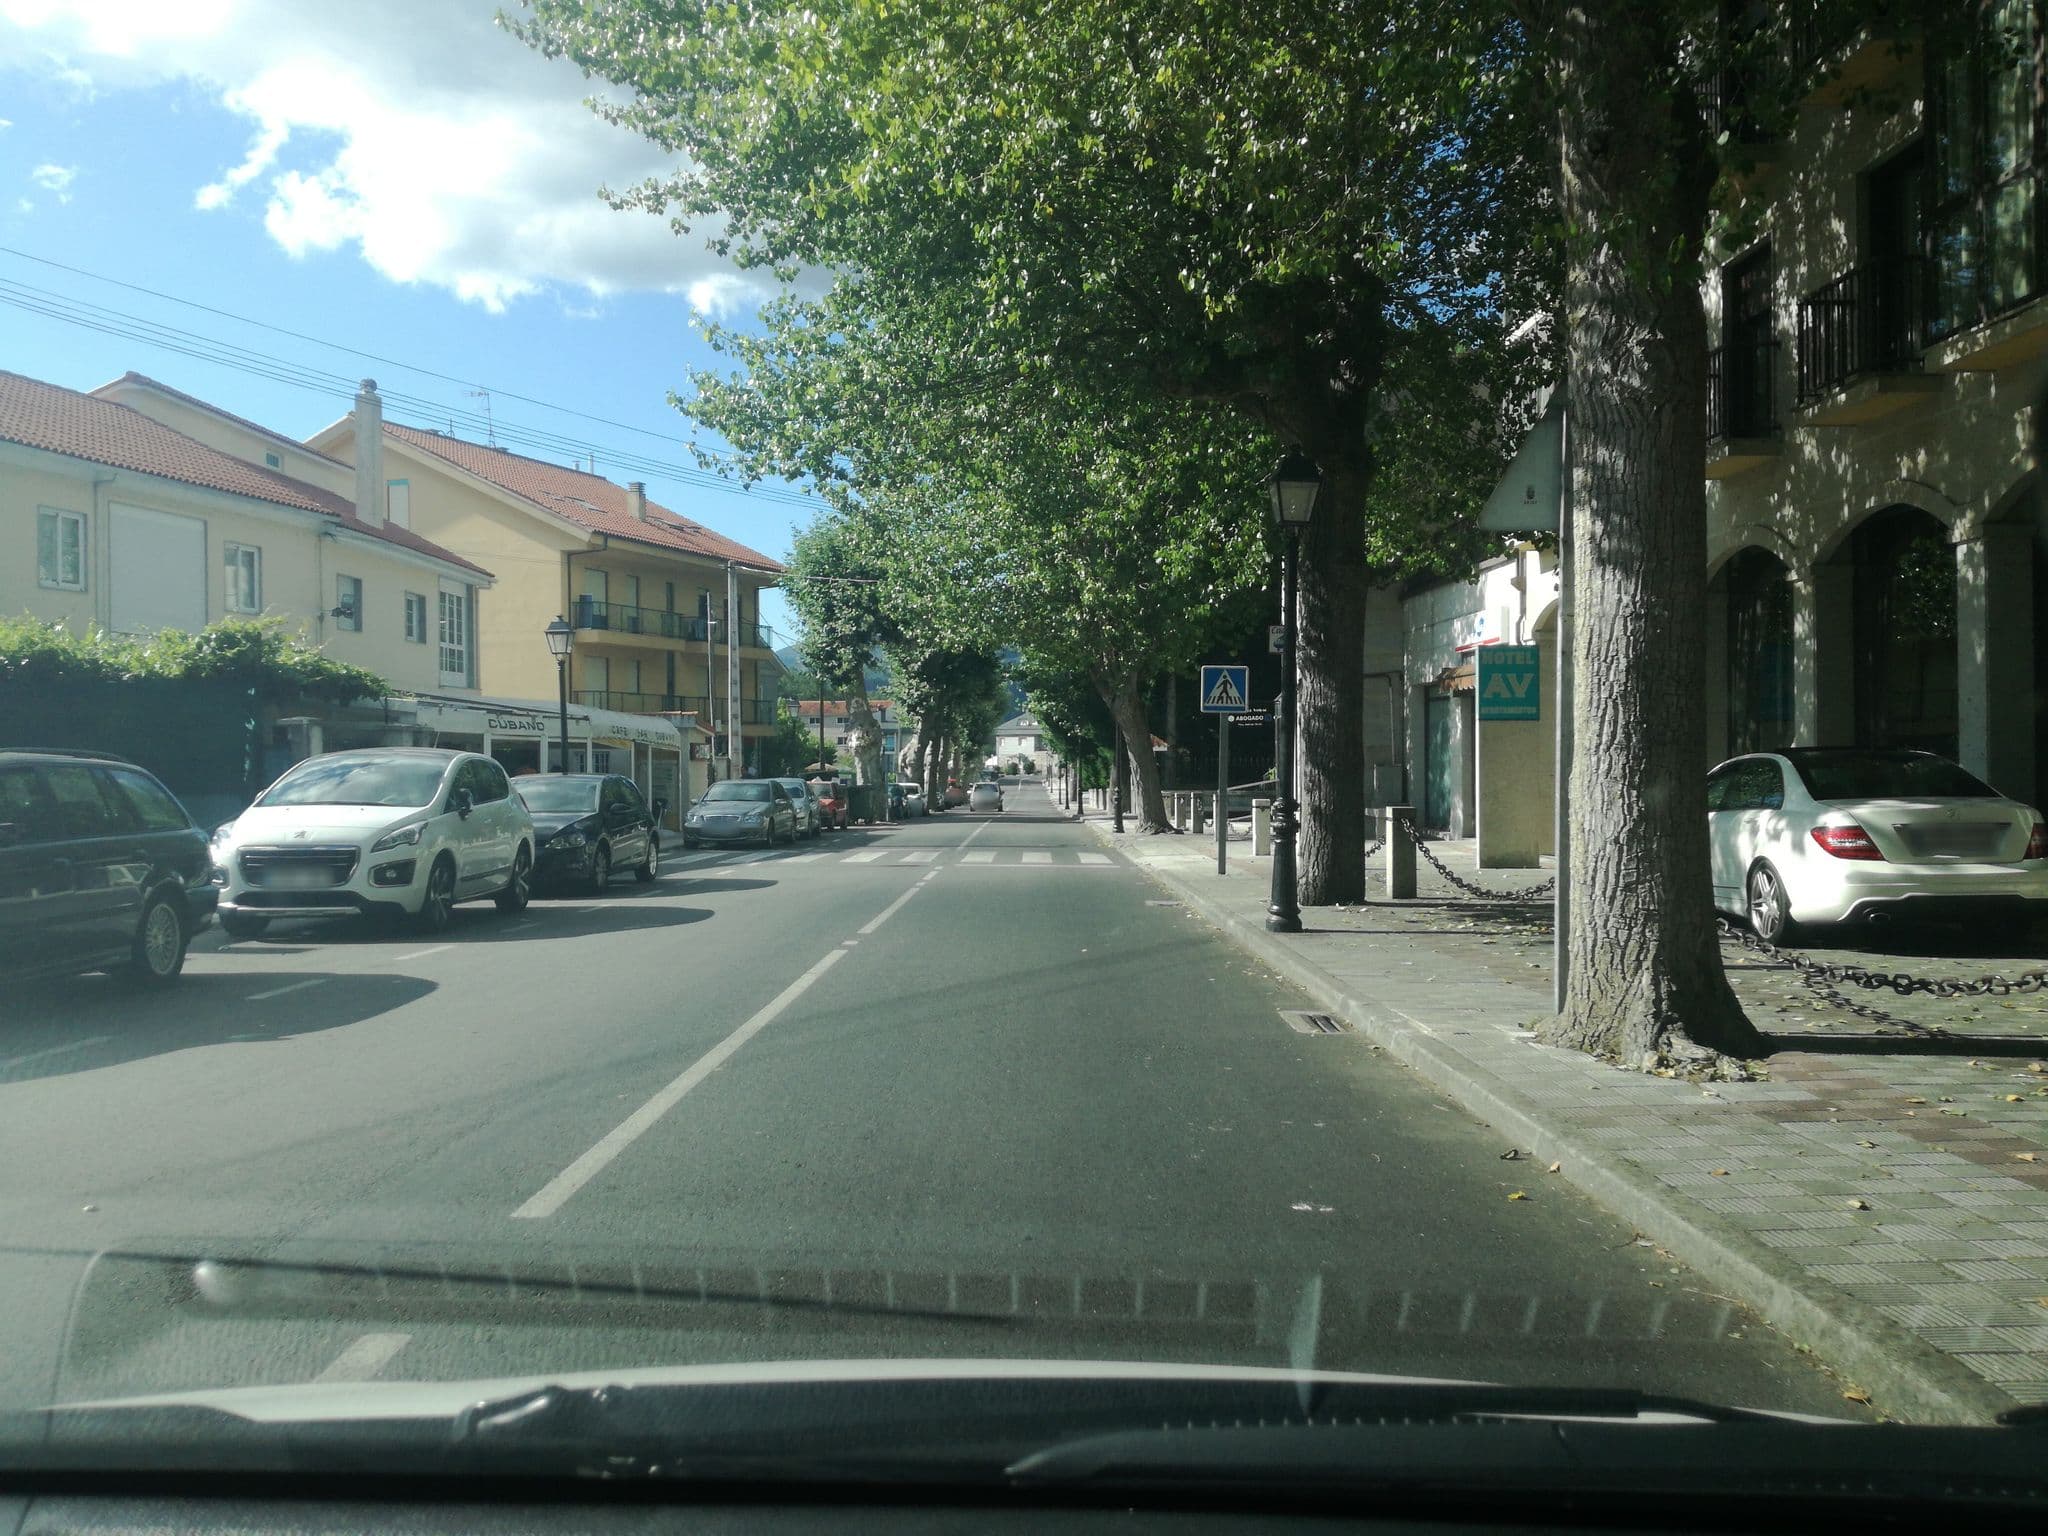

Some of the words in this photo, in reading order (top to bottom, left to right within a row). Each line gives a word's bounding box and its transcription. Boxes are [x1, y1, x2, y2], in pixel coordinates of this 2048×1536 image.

[1481, 651, 1535, 665] HOTEL
[1482, 672, 1535, 698] AV
[487, 718, 545, 731] CUBANO
